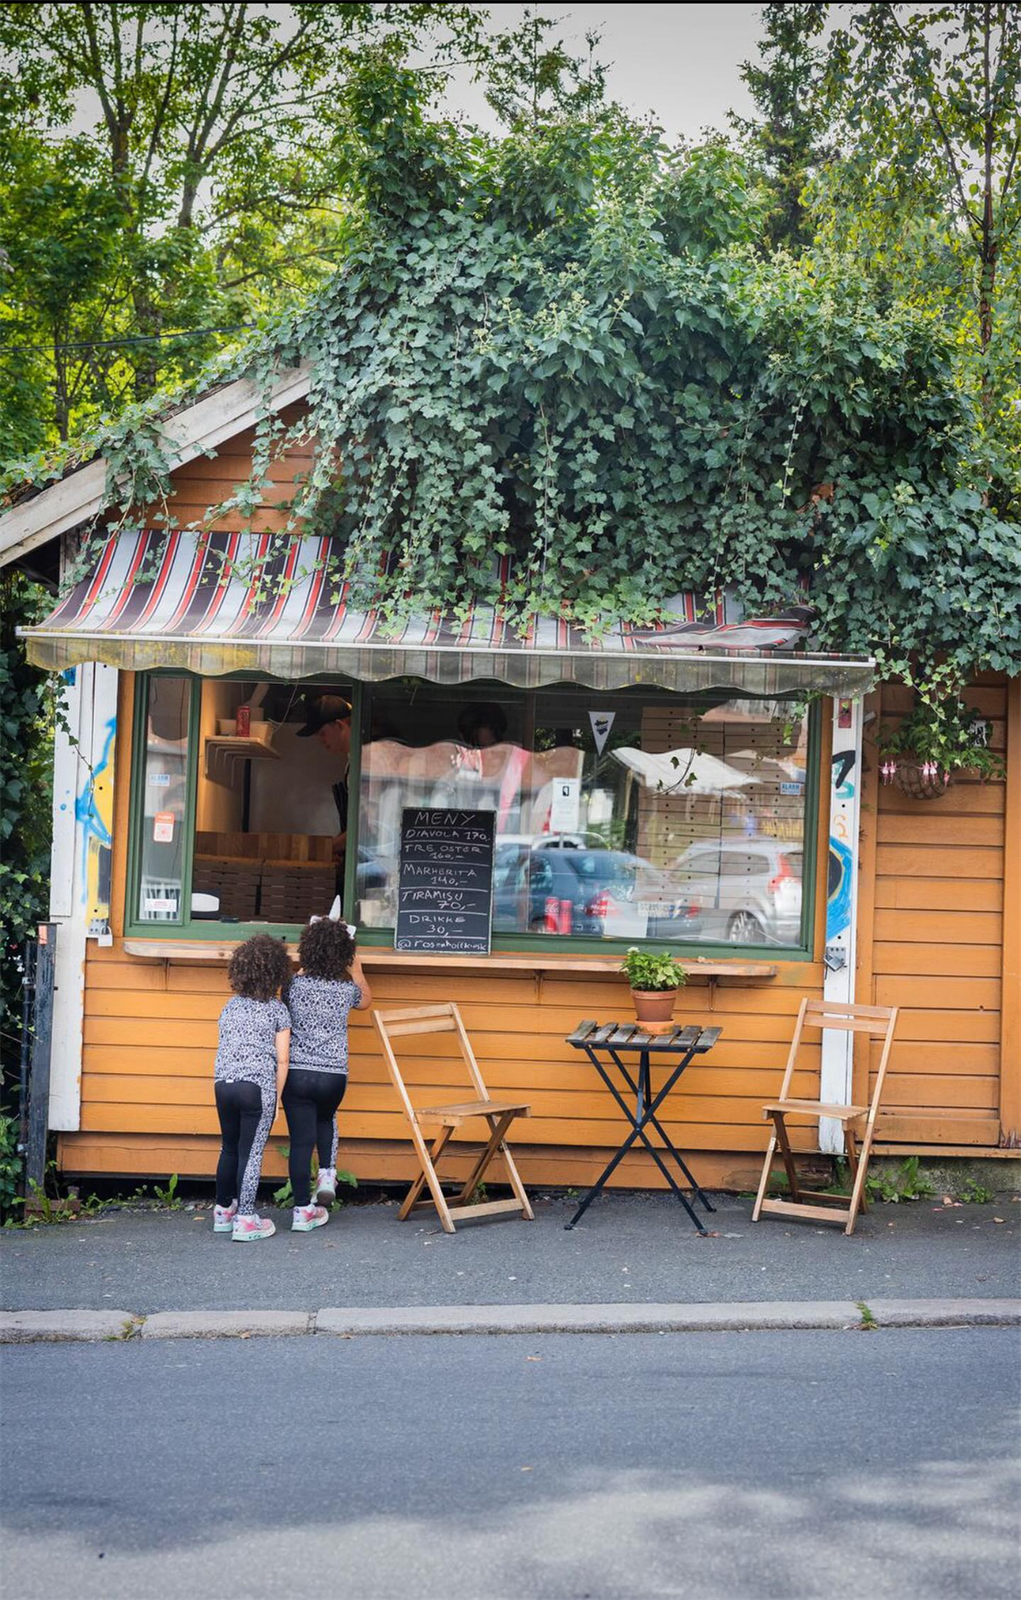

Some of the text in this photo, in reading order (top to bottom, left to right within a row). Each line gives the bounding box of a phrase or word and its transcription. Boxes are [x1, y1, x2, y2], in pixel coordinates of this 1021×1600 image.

[414, 811, 476, 826] MENY
[405, 829, 460, 839] DIAVOLA
[404, 844, 482, 854] TRE OSTER
[402, 890, 463, 902] TIRAMISU
[409, 914, 466, 924] DRIKKE
